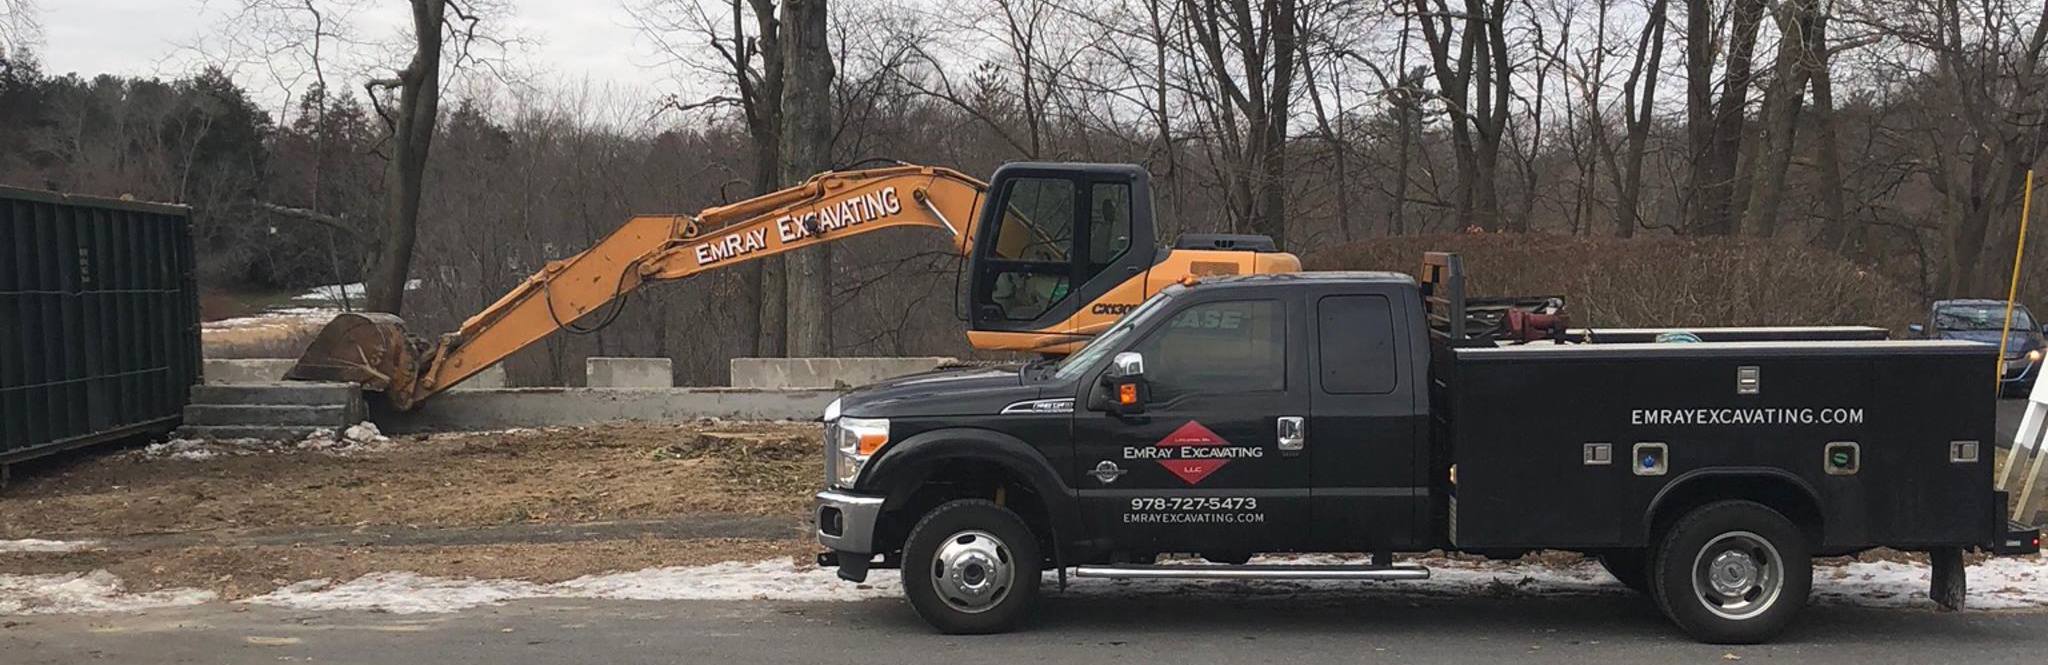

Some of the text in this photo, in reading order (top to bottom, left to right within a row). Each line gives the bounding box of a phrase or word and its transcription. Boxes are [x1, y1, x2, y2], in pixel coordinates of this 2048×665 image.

[1092, 303, 1138, 315] CX130
[1631, 408, 1864, 425] EMRAYEXCAVATING.COM
[1180, 446, 1264, 458] EXCAVATING
[1131, 498, 1257, 510] 978-727-5473
[1123, 513, 1264, 523] EMRAYEXCAVATING.COM
